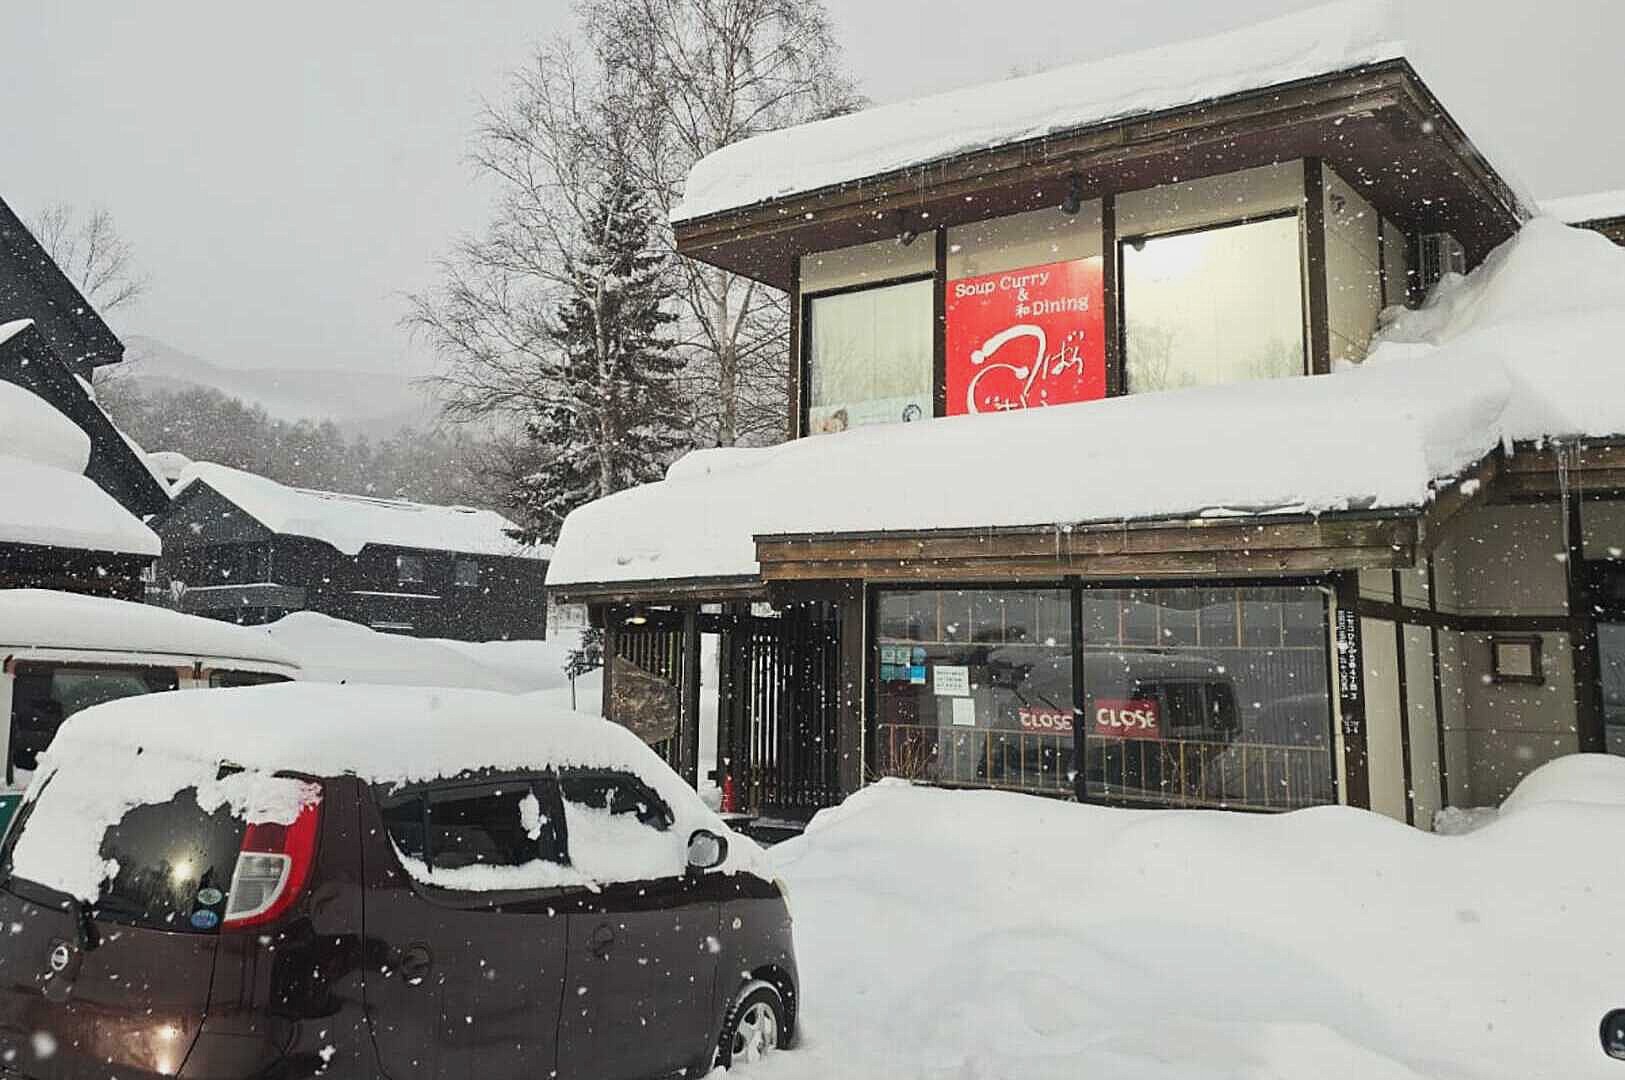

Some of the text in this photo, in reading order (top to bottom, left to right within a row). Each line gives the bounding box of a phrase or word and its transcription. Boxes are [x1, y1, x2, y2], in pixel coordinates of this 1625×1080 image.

[955, 272, 1049, 298] Soup Curry
[1017, 288, 1029, 302] &
[1020, 712, 1073, 730] CLOSE
[1096, 708, 1156, 729] CLOSE
